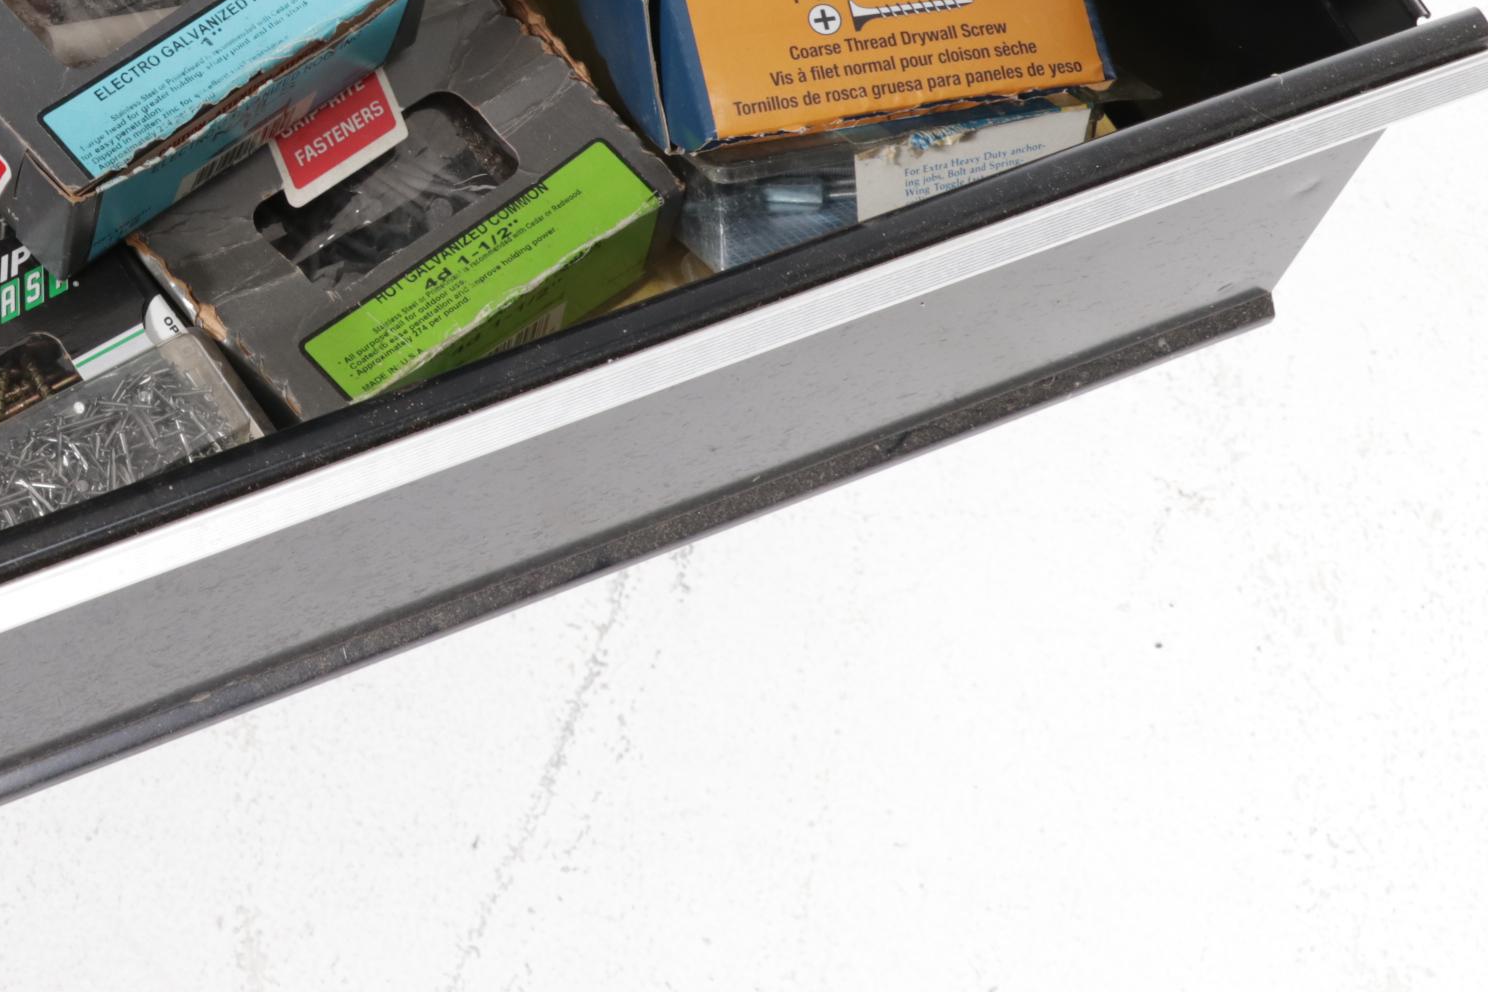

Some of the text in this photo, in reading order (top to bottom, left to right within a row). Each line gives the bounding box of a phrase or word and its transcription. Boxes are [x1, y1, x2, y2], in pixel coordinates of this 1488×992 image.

[769, 38, 1037, 87] Vis à filet normal pour cloison sèche
[788, 19, 1007, 61] Coarse Thread Drywall Screw
[93, 51, 162, 102] ELECTRO
[733, 61, 1084, 116] Tornillos de rosca gruesa para paneles de yeso
[292, 98, 386, 167] FASTENERS
[903, 141, 1046, 176] For Extra Heavy Duty anchor-
[904, 178, 920, 187] ing
[947, 167, 966, 178] Bolt
[970, 163, 986, 173] and
[989, 156, 1024, 170] Spring-
[905, 185, 930, 196] Wing
[374, 180, 549, 305] HOT GALVANIZED COMMON
[421, 218, 522, 291] 4d 1-1/2"
[162, 314, 180, 335] OP
